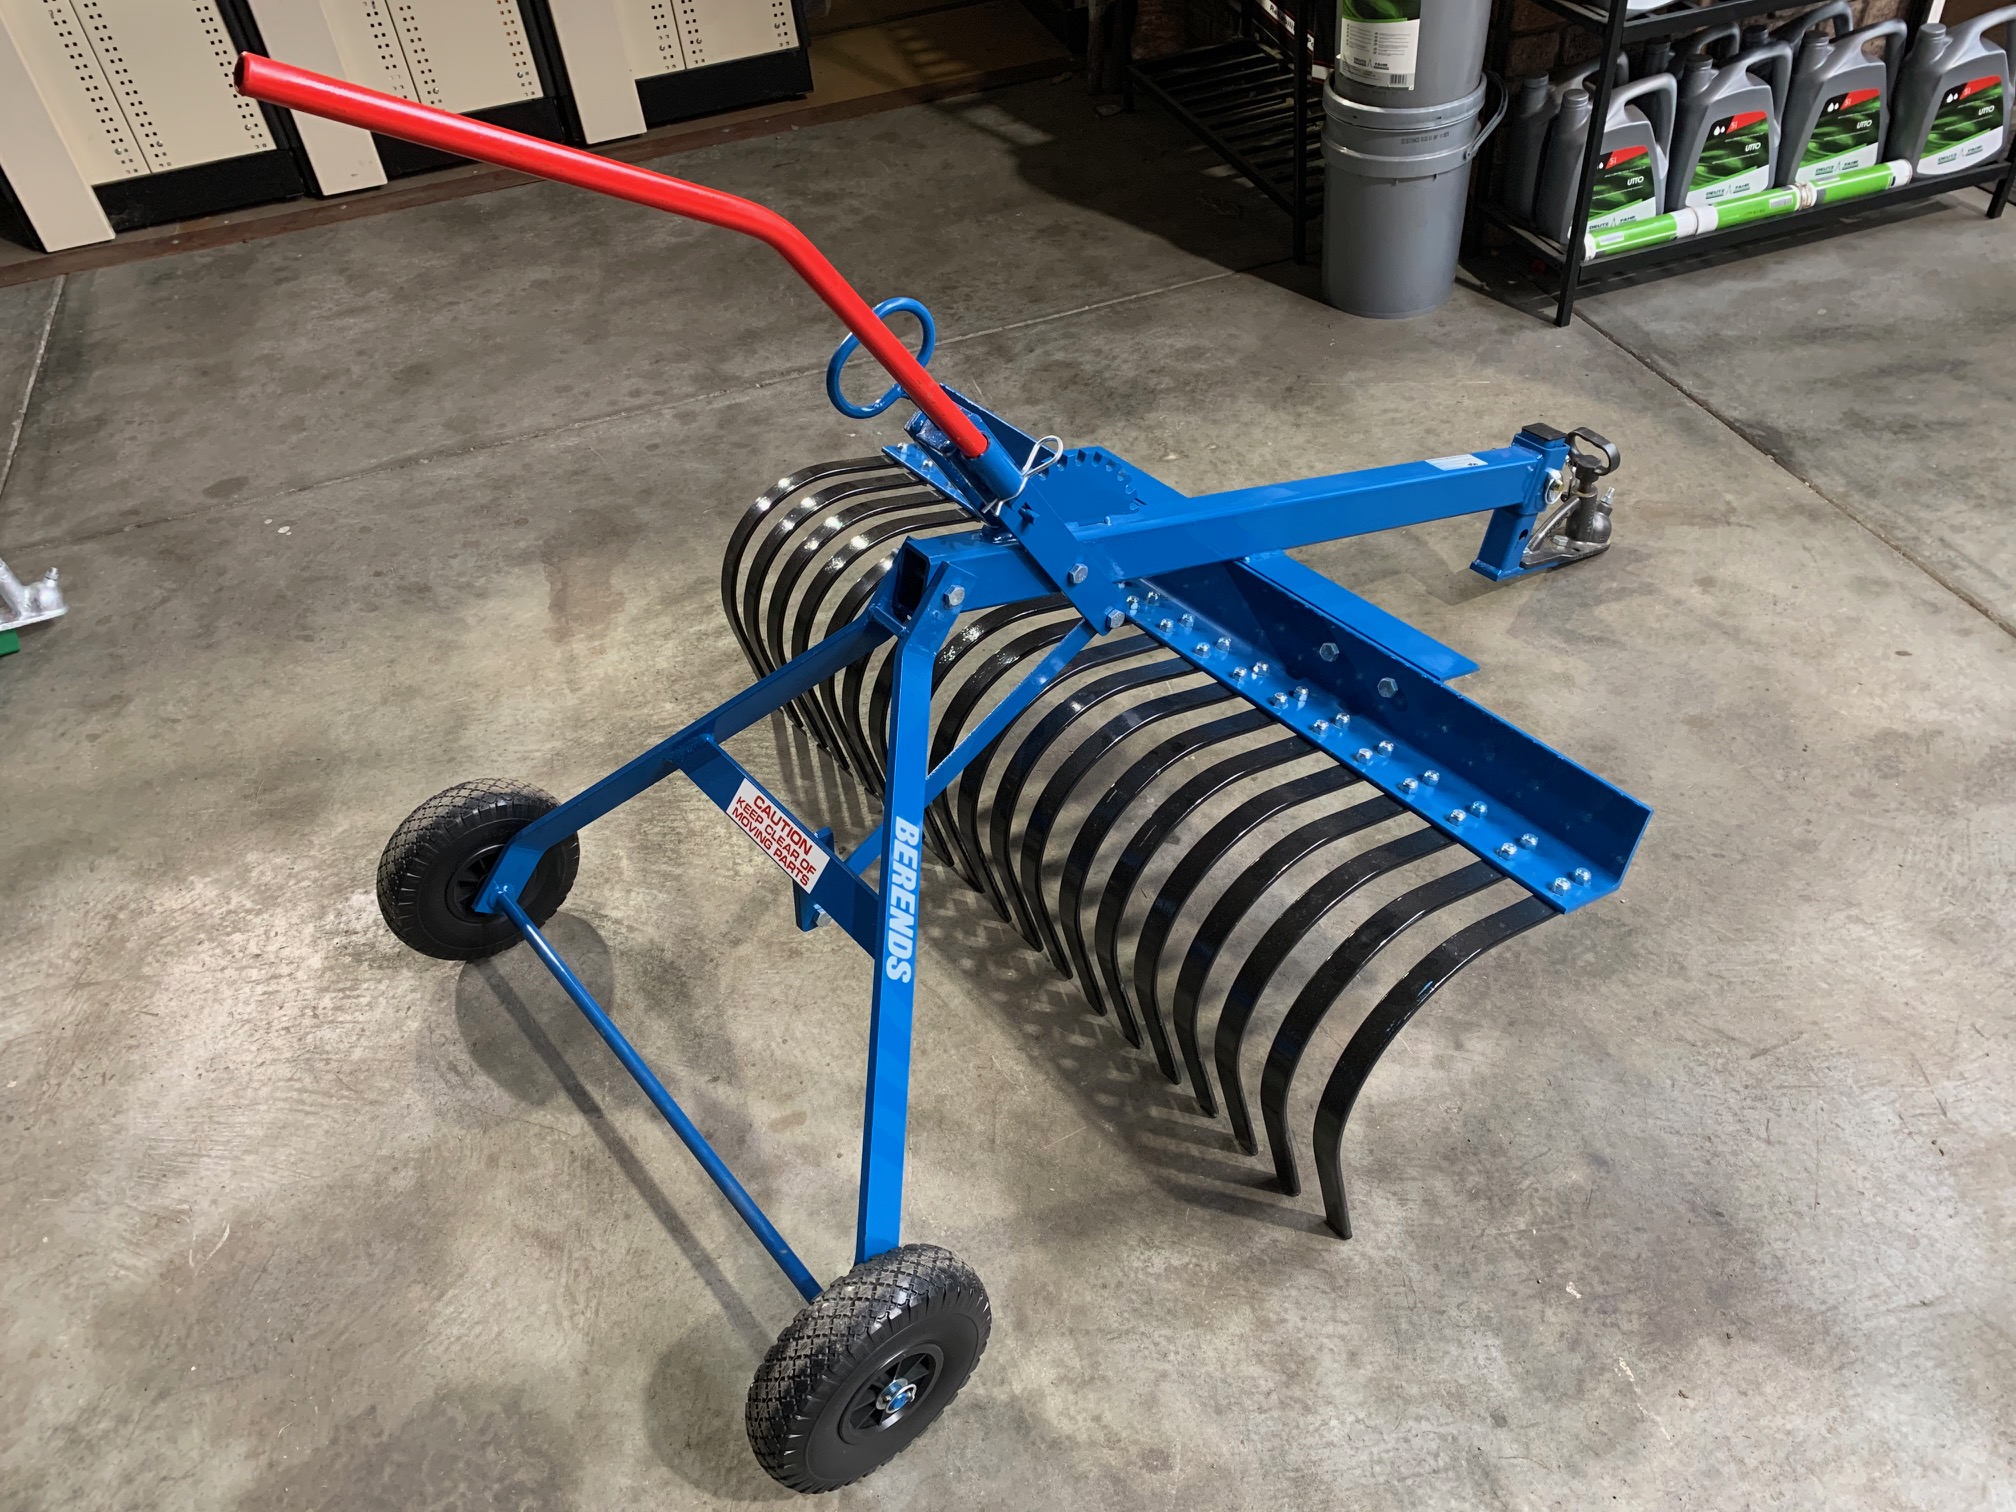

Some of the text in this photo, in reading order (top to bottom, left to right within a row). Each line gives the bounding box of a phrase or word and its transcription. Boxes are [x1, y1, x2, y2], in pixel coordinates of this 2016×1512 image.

[1978, 105, 1995, 116] UTTO
[1856, 119, 1873, 129] UTTO
[1745, 142, 1762, 152] UTTO
[1627, 176, 1645, 186] UTTO
[1589, 222, 1609, 230] DEUTZ
[753, 795, 813, 856] CAUTION
[736, 796, 816, 875] KEEP CLEAR OF
[732, 807, 810, 886] MOVING PARTS
[886, 816, 919, 984] BERENDS
